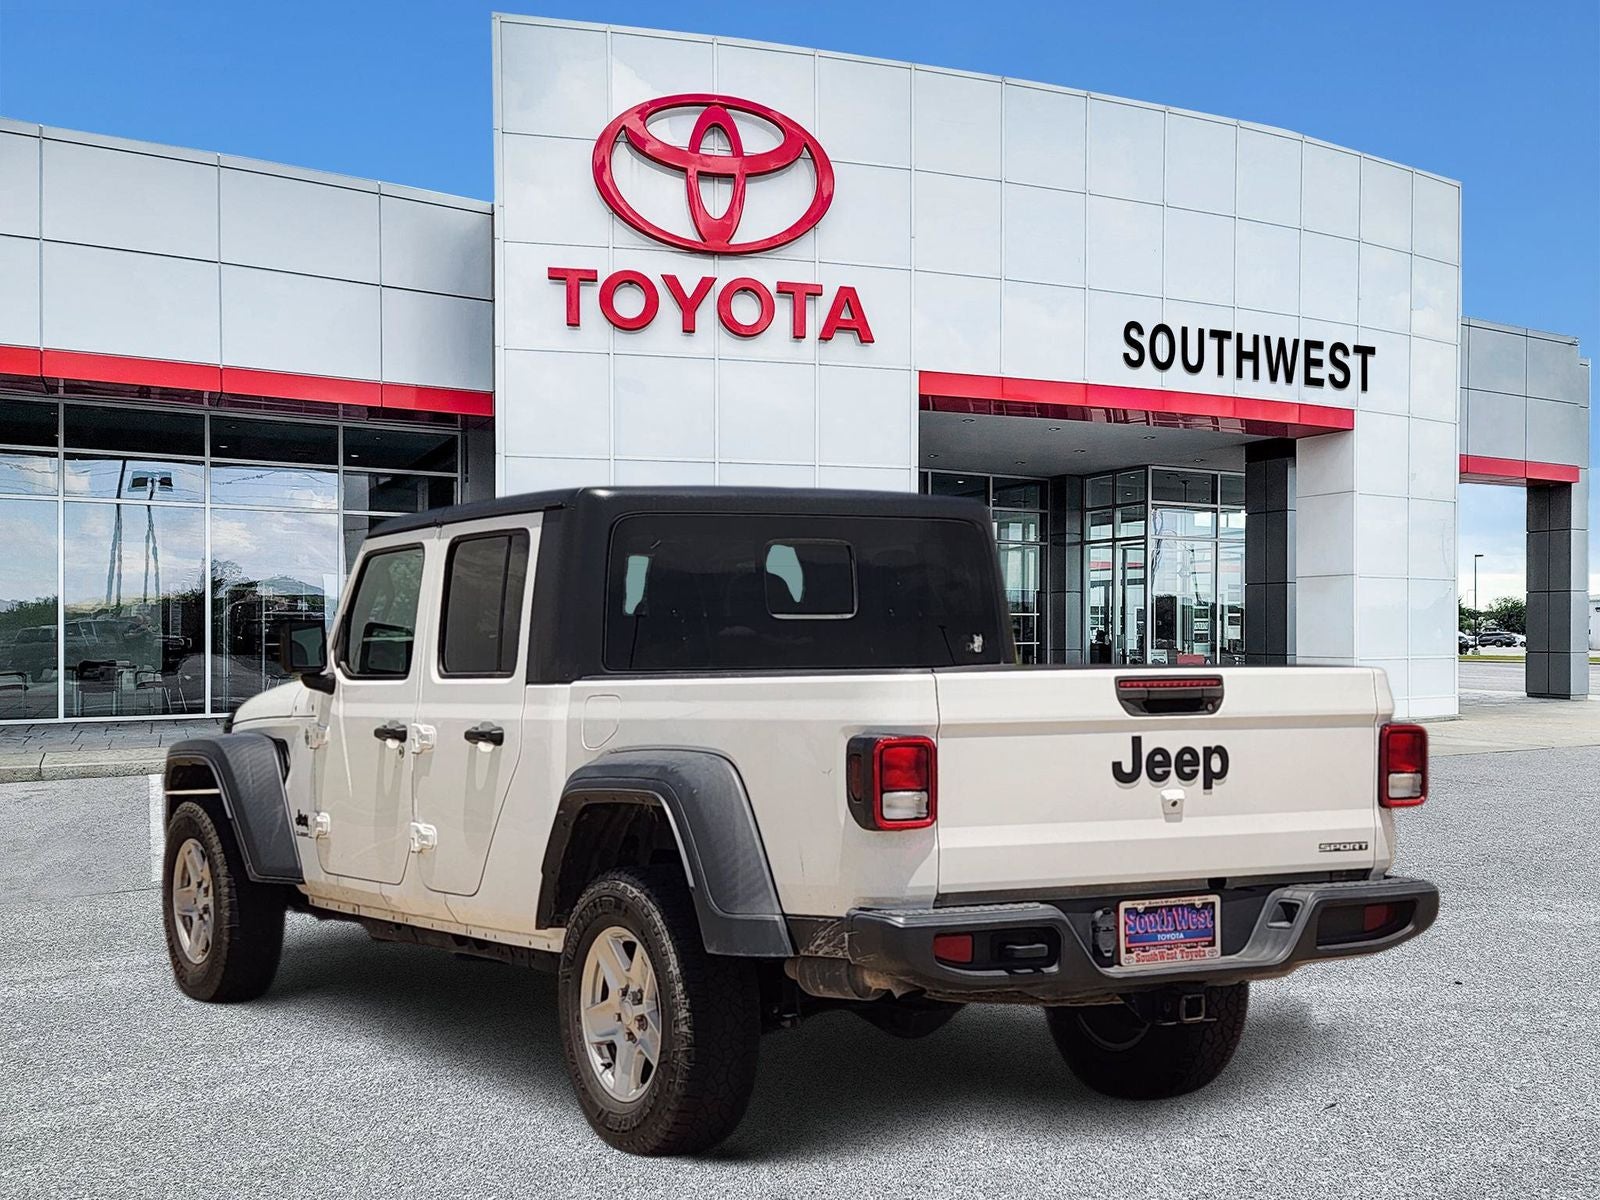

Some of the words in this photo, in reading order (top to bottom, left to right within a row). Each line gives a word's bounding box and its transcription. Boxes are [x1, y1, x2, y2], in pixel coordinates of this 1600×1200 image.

[547, 266, 875, 344] TOYOTA
[1122, 320, 1376, 392] SOUTHWEST
[1111, 735, 1230, 791] Jeep
[1319, 841, 1368, 852] SPORT
[1125, 904, 1214, 934] SouthWest
[1157, 932, 1185, 941] TOYOTA
[1135, 950, 1178, 963] SouthWest
[1180, 947, 1206, 960] Toyota
